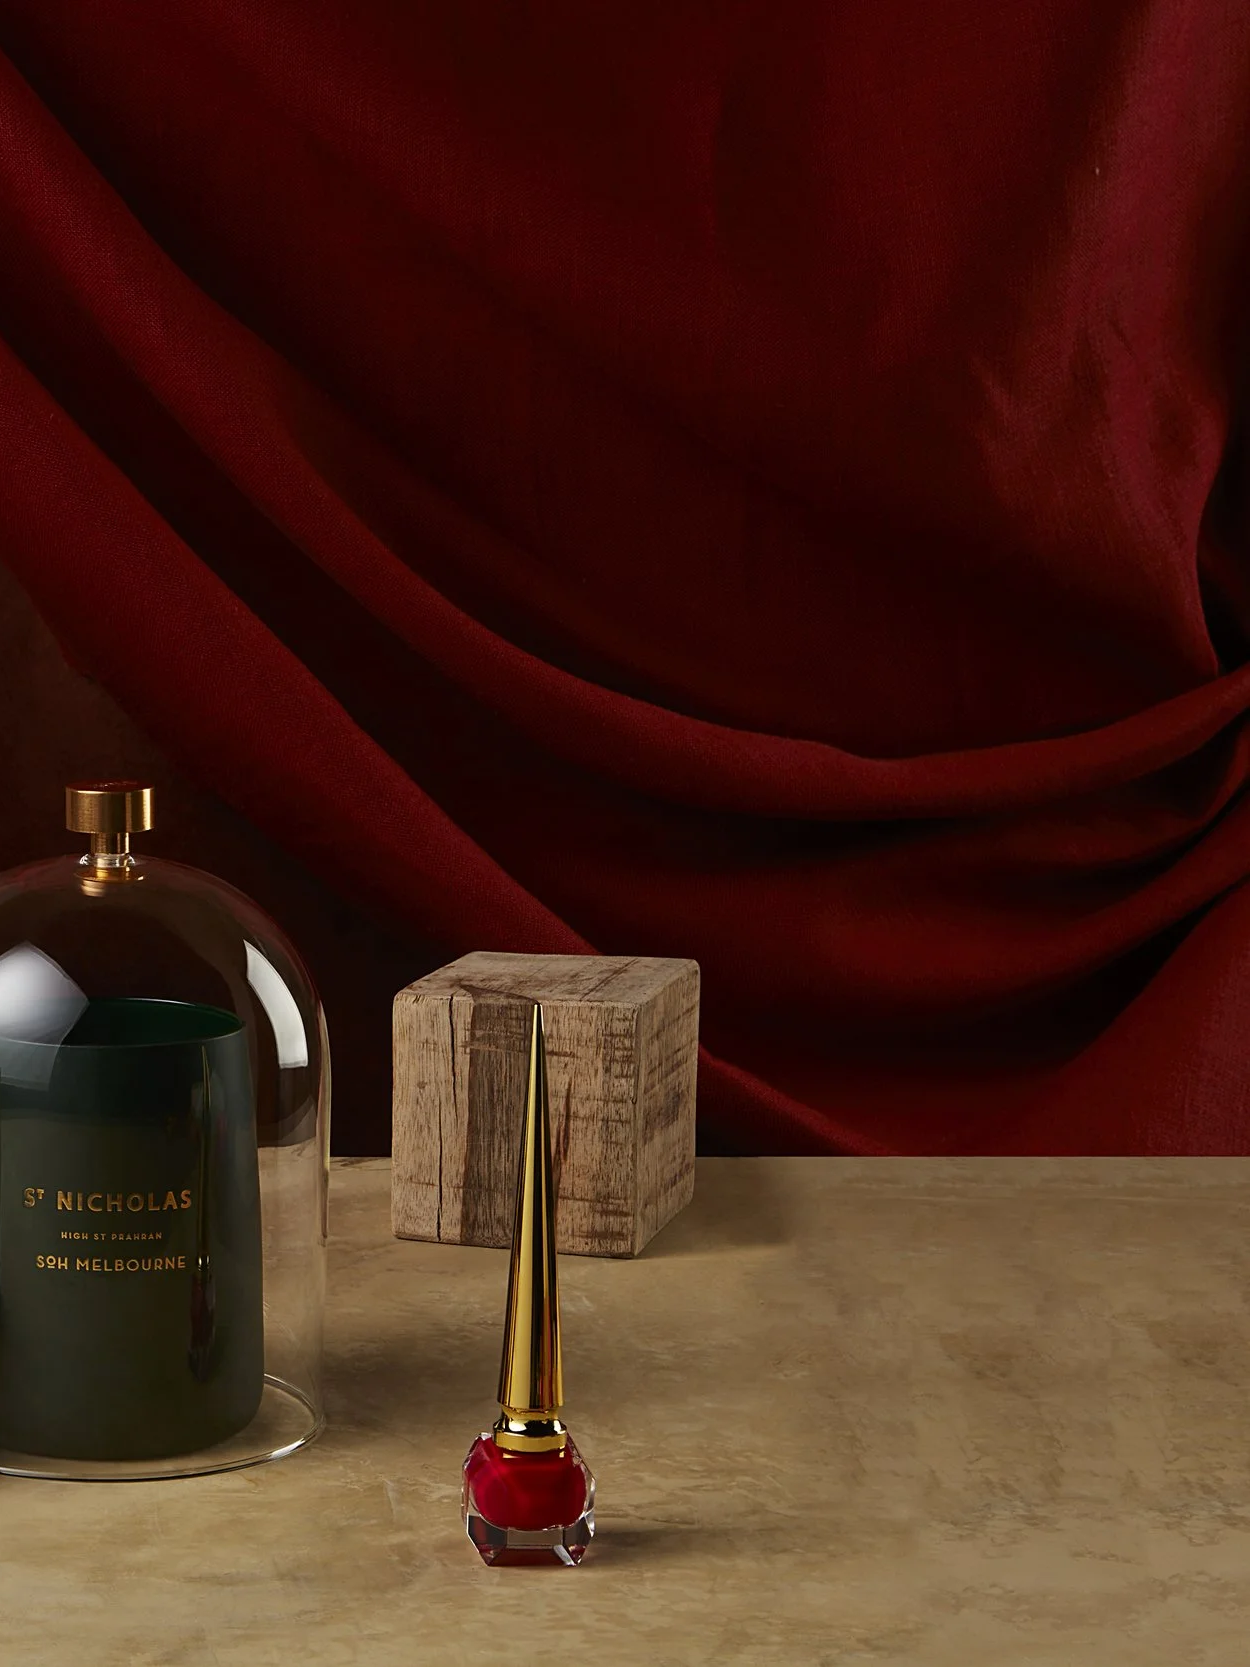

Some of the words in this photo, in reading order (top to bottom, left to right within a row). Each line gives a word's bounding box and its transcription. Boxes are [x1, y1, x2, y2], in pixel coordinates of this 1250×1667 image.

[57, 1189, 192, 1212] NICHOLAS
[61, 1231, 89, 1240] HIGH
[93, 1233, 106, 1241] ST
[111, 1232, 163, 1241] PRAHRAN
[76, 1255, 186, 1272] MELBOURNE
